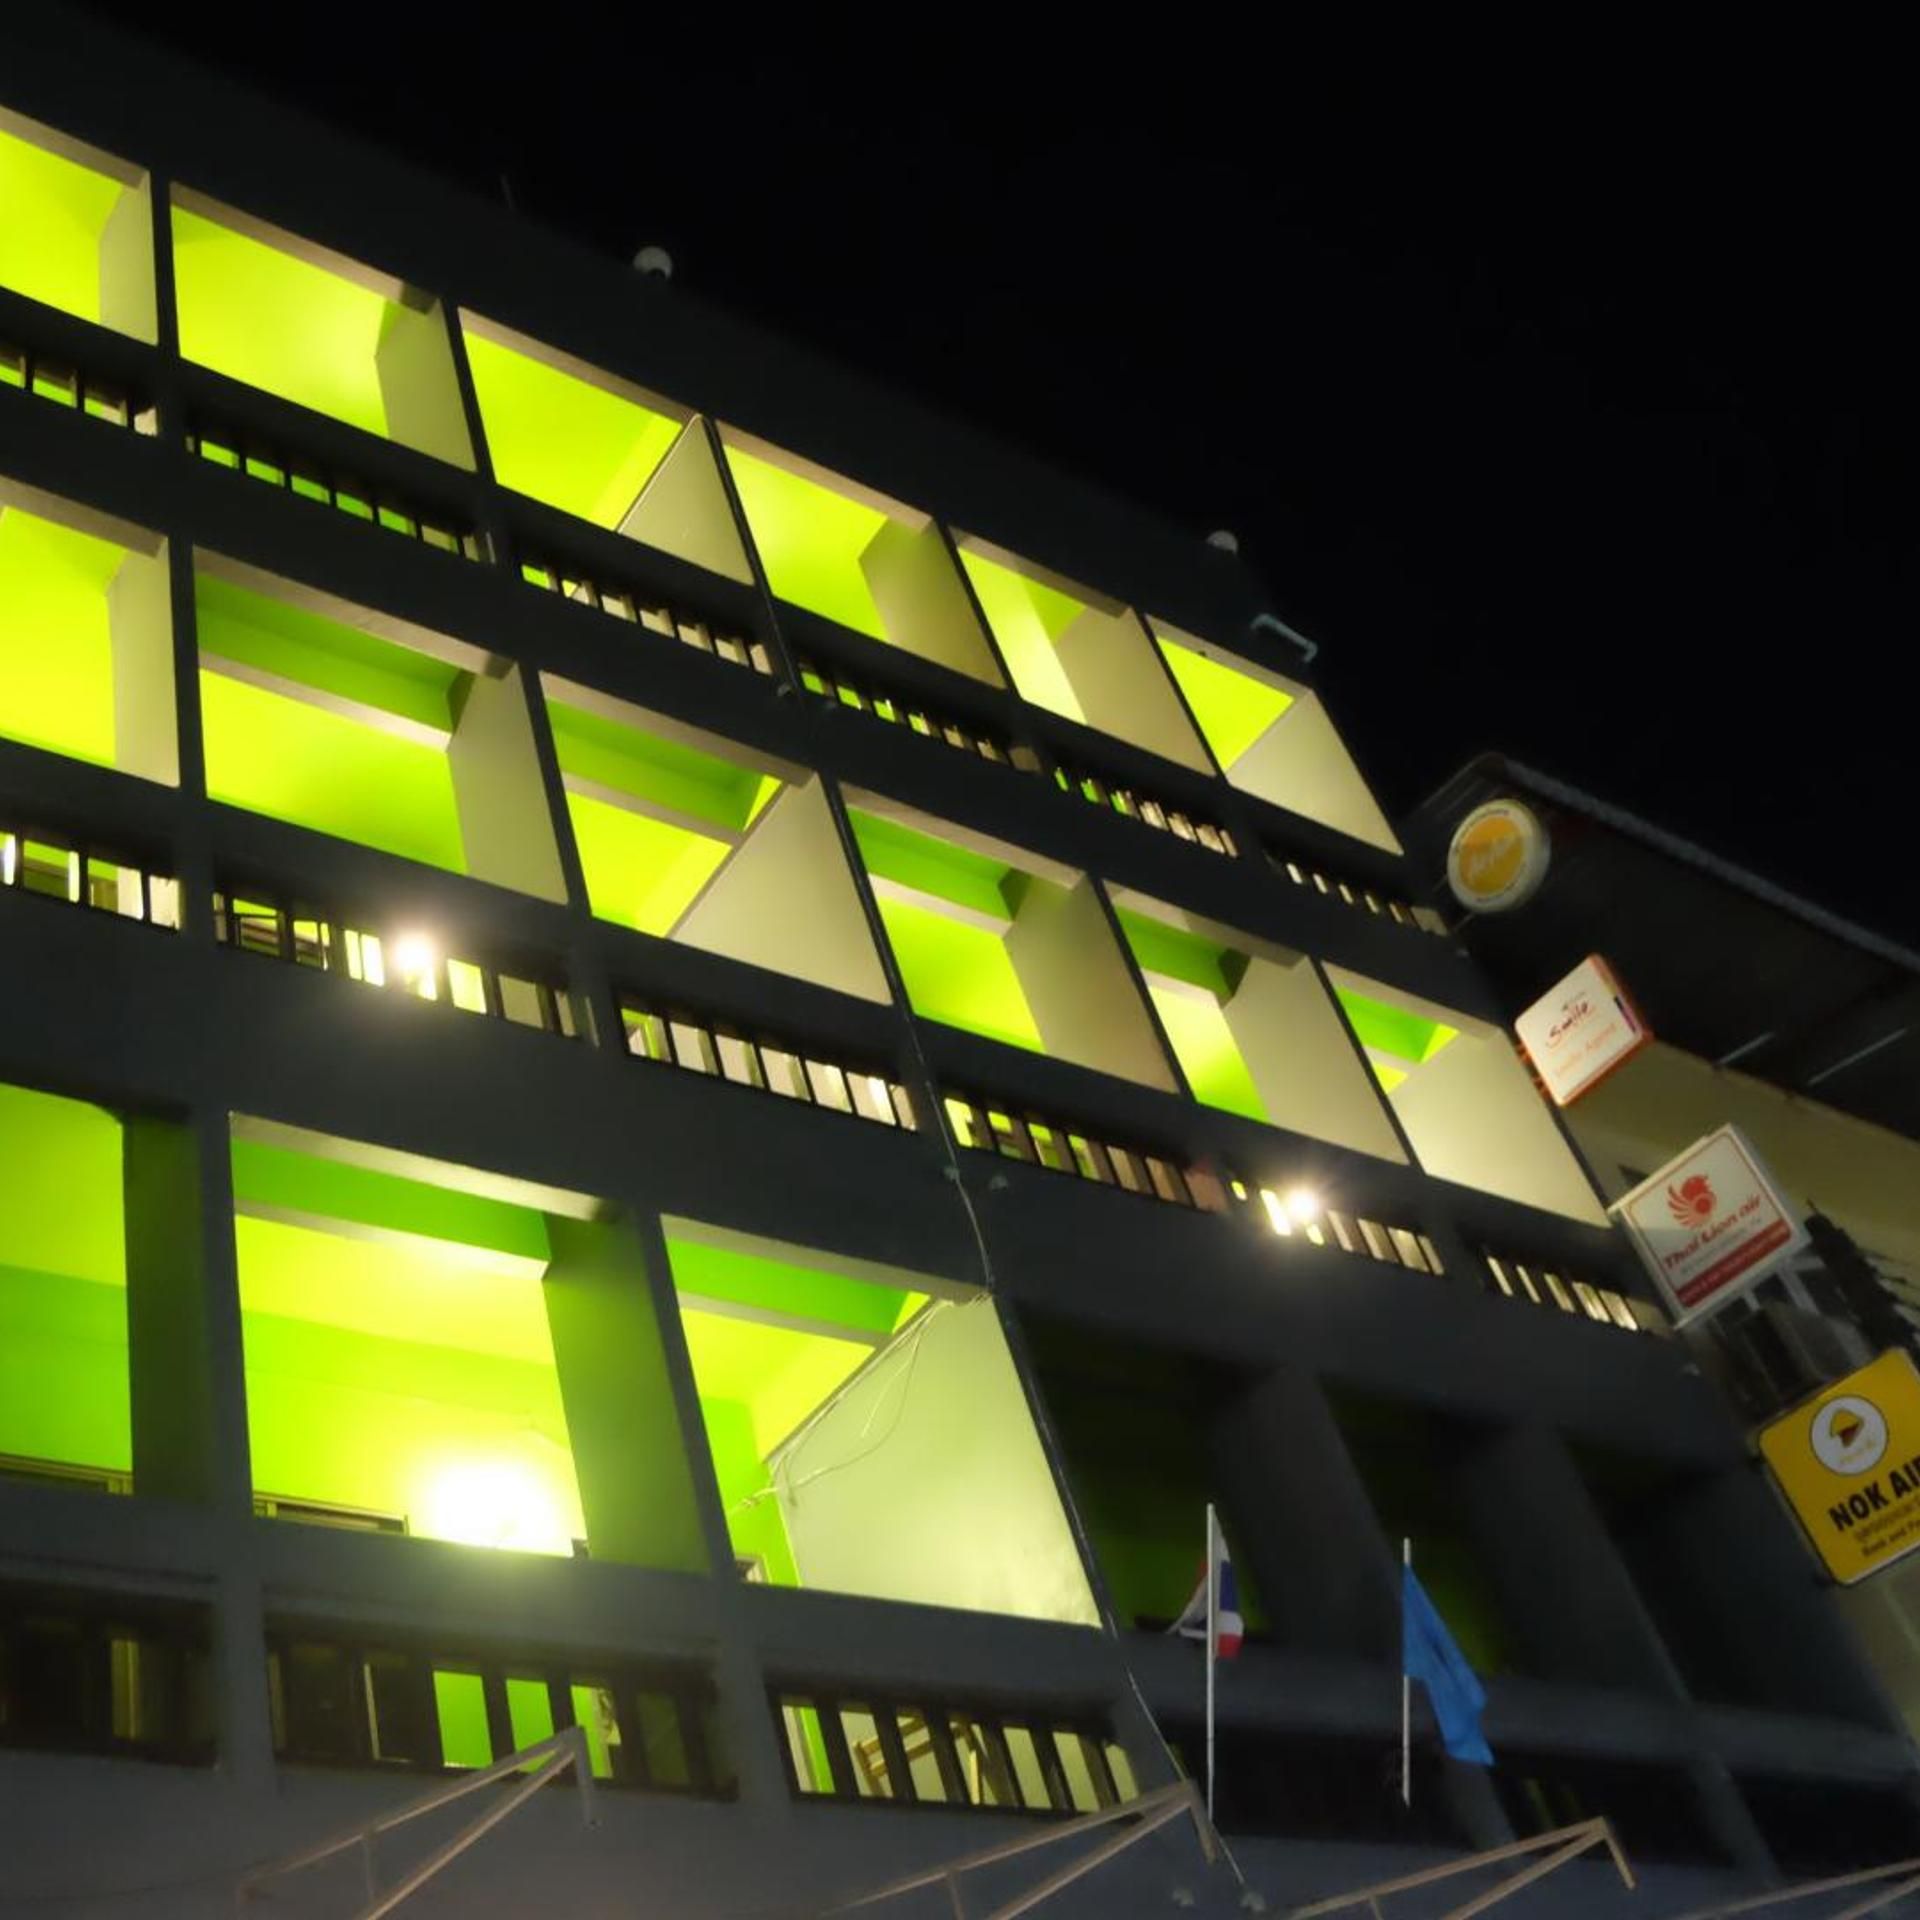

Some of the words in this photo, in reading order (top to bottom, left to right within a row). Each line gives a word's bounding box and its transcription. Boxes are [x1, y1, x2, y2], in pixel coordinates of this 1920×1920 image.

[1664, 1234, 1699, 1269] Thai
[1701, 1211, 1738, 1243] Lion
[1828, 1481, 1889, 1532] NOK
